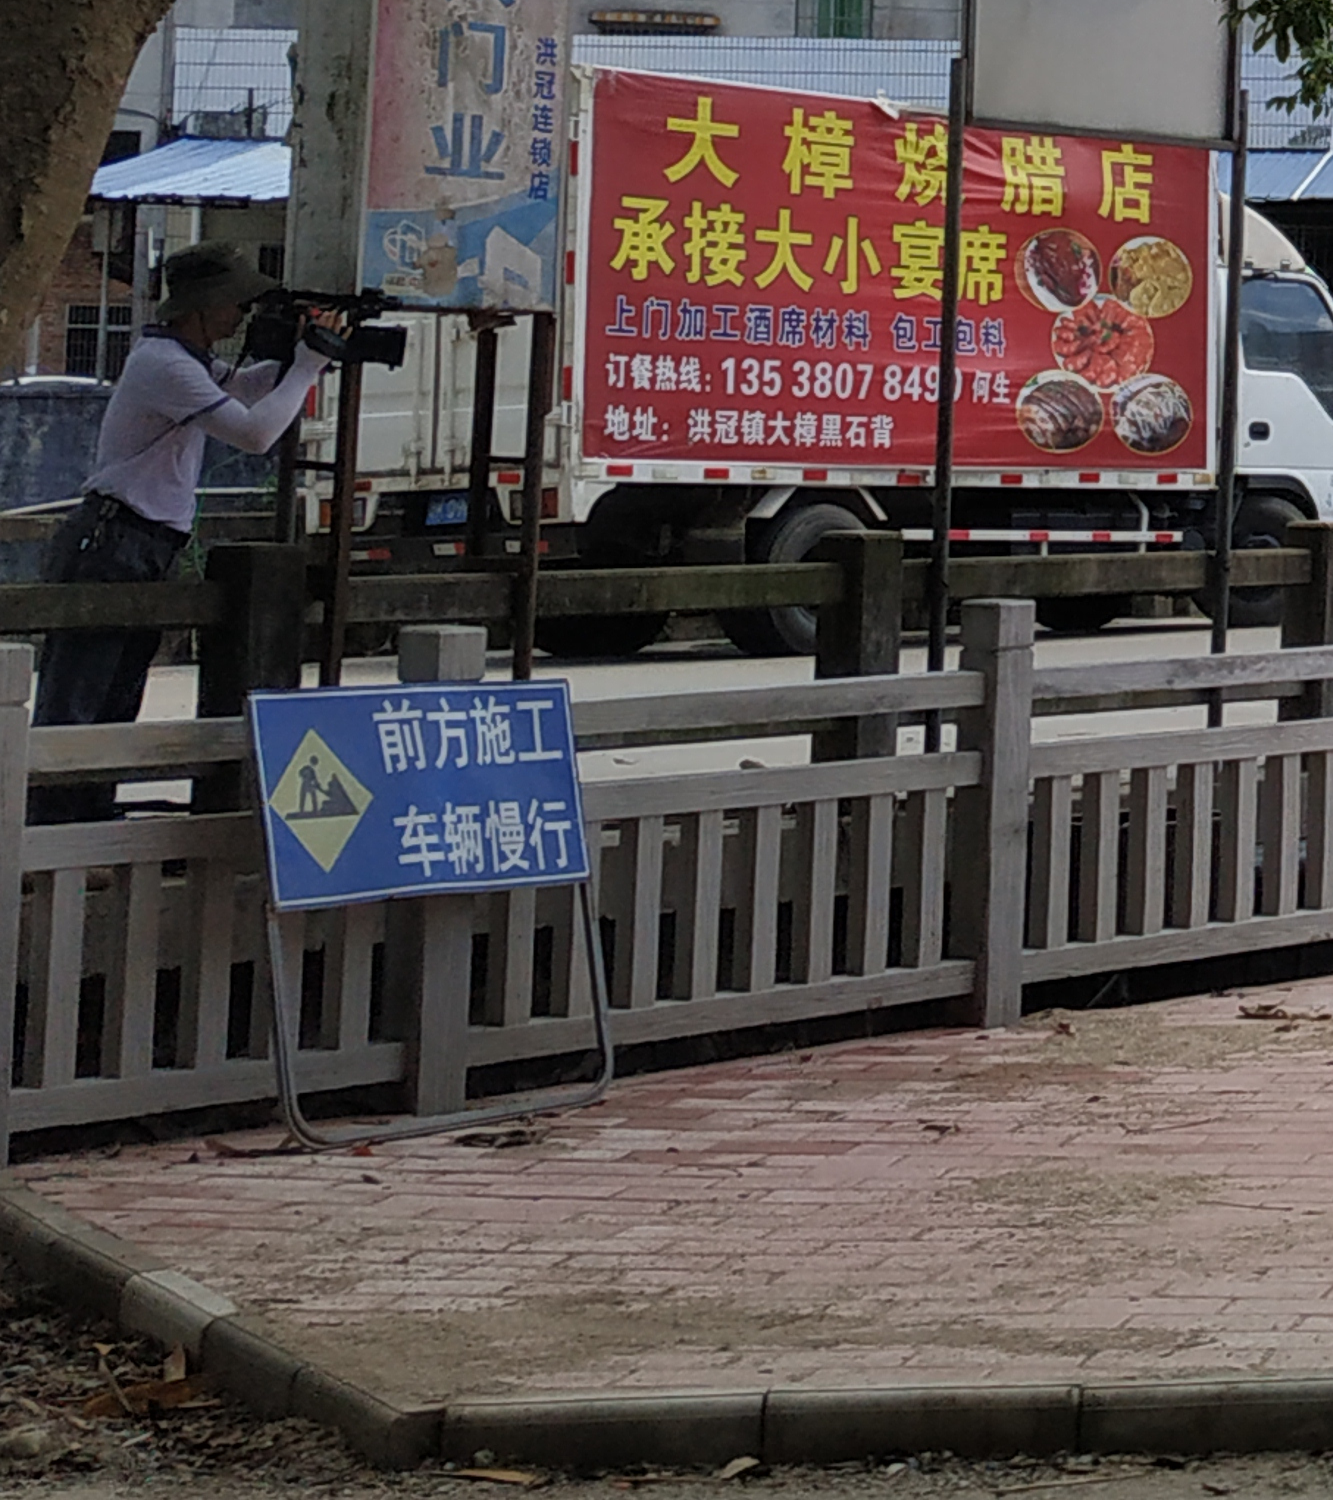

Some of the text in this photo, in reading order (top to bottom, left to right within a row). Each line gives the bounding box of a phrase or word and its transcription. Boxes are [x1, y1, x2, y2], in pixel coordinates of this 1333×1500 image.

[528, 37, 560, 202] 洪冠连锁店
[663, 96, 1155, 225] 大樟烧腊店
[609, 195, 1008, 306] 承接大小宴席
[605, 295, 1006, 357] 上门加工酒席材料 包工包料
[720, 356, 783, 397] 135
[790, 359, 872, 401] 3807
[882, 363, 963, 403] 849
[972, 369, 1011, 404] 何生
[372, 695, 564, 775] 前方施工
[393, 798, 572, 878] 车辆慢行
